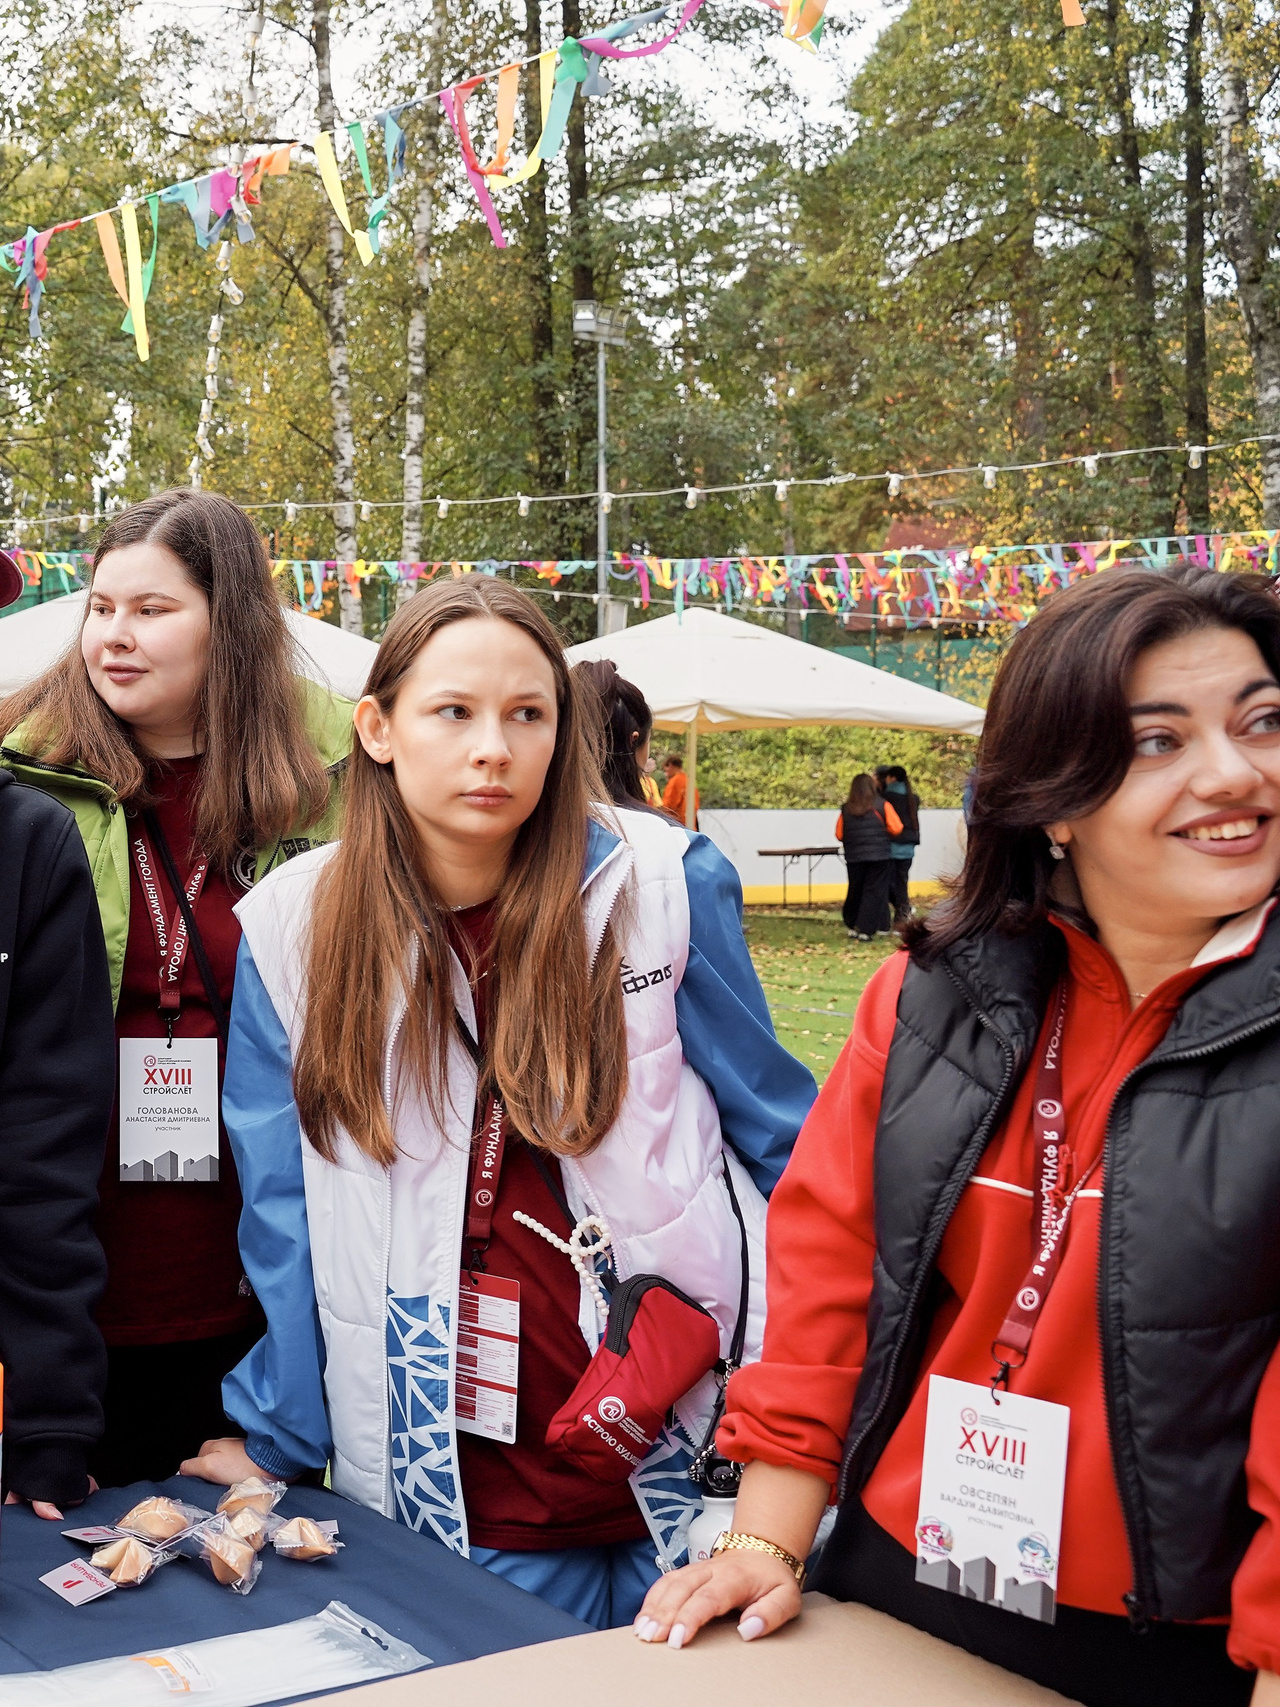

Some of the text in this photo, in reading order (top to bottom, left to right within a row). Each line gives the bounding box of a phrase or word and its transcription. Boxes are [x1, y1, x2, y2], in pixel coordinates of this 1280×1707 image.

[134, 838, 153, 881] ГОРОДА
[145, 882, 168, 948] ФУНДАМЕНТ
[168, 936, 185, 982] ГОРОДА
[143, 1068, 192, 1085] XVIII
[143, 1085, 192, 1095] СТРОЙСЛЁТ
[137, 1107, 198, 1115] ГОЛОВАНОВА
[1043, 1130, 1059, 1141] Я
[481, 1171, 493, 1179] Я
[1032, 1264, 1046, 1277] Я
[582, 1413, 618, 1446] #СТРОЮ
[958, 1426, 1026, 1465] XVIII
[955, 1454, 1025, 1480] СТРОЙСЛЁТ
[959, 1484, 1017, 1508] ОВСЕПЯН
[977, 1504, 1035, 1526] ДАВИТОВНА
[70, 1562, 107, 1588] РЕНОВАЦИЯ
